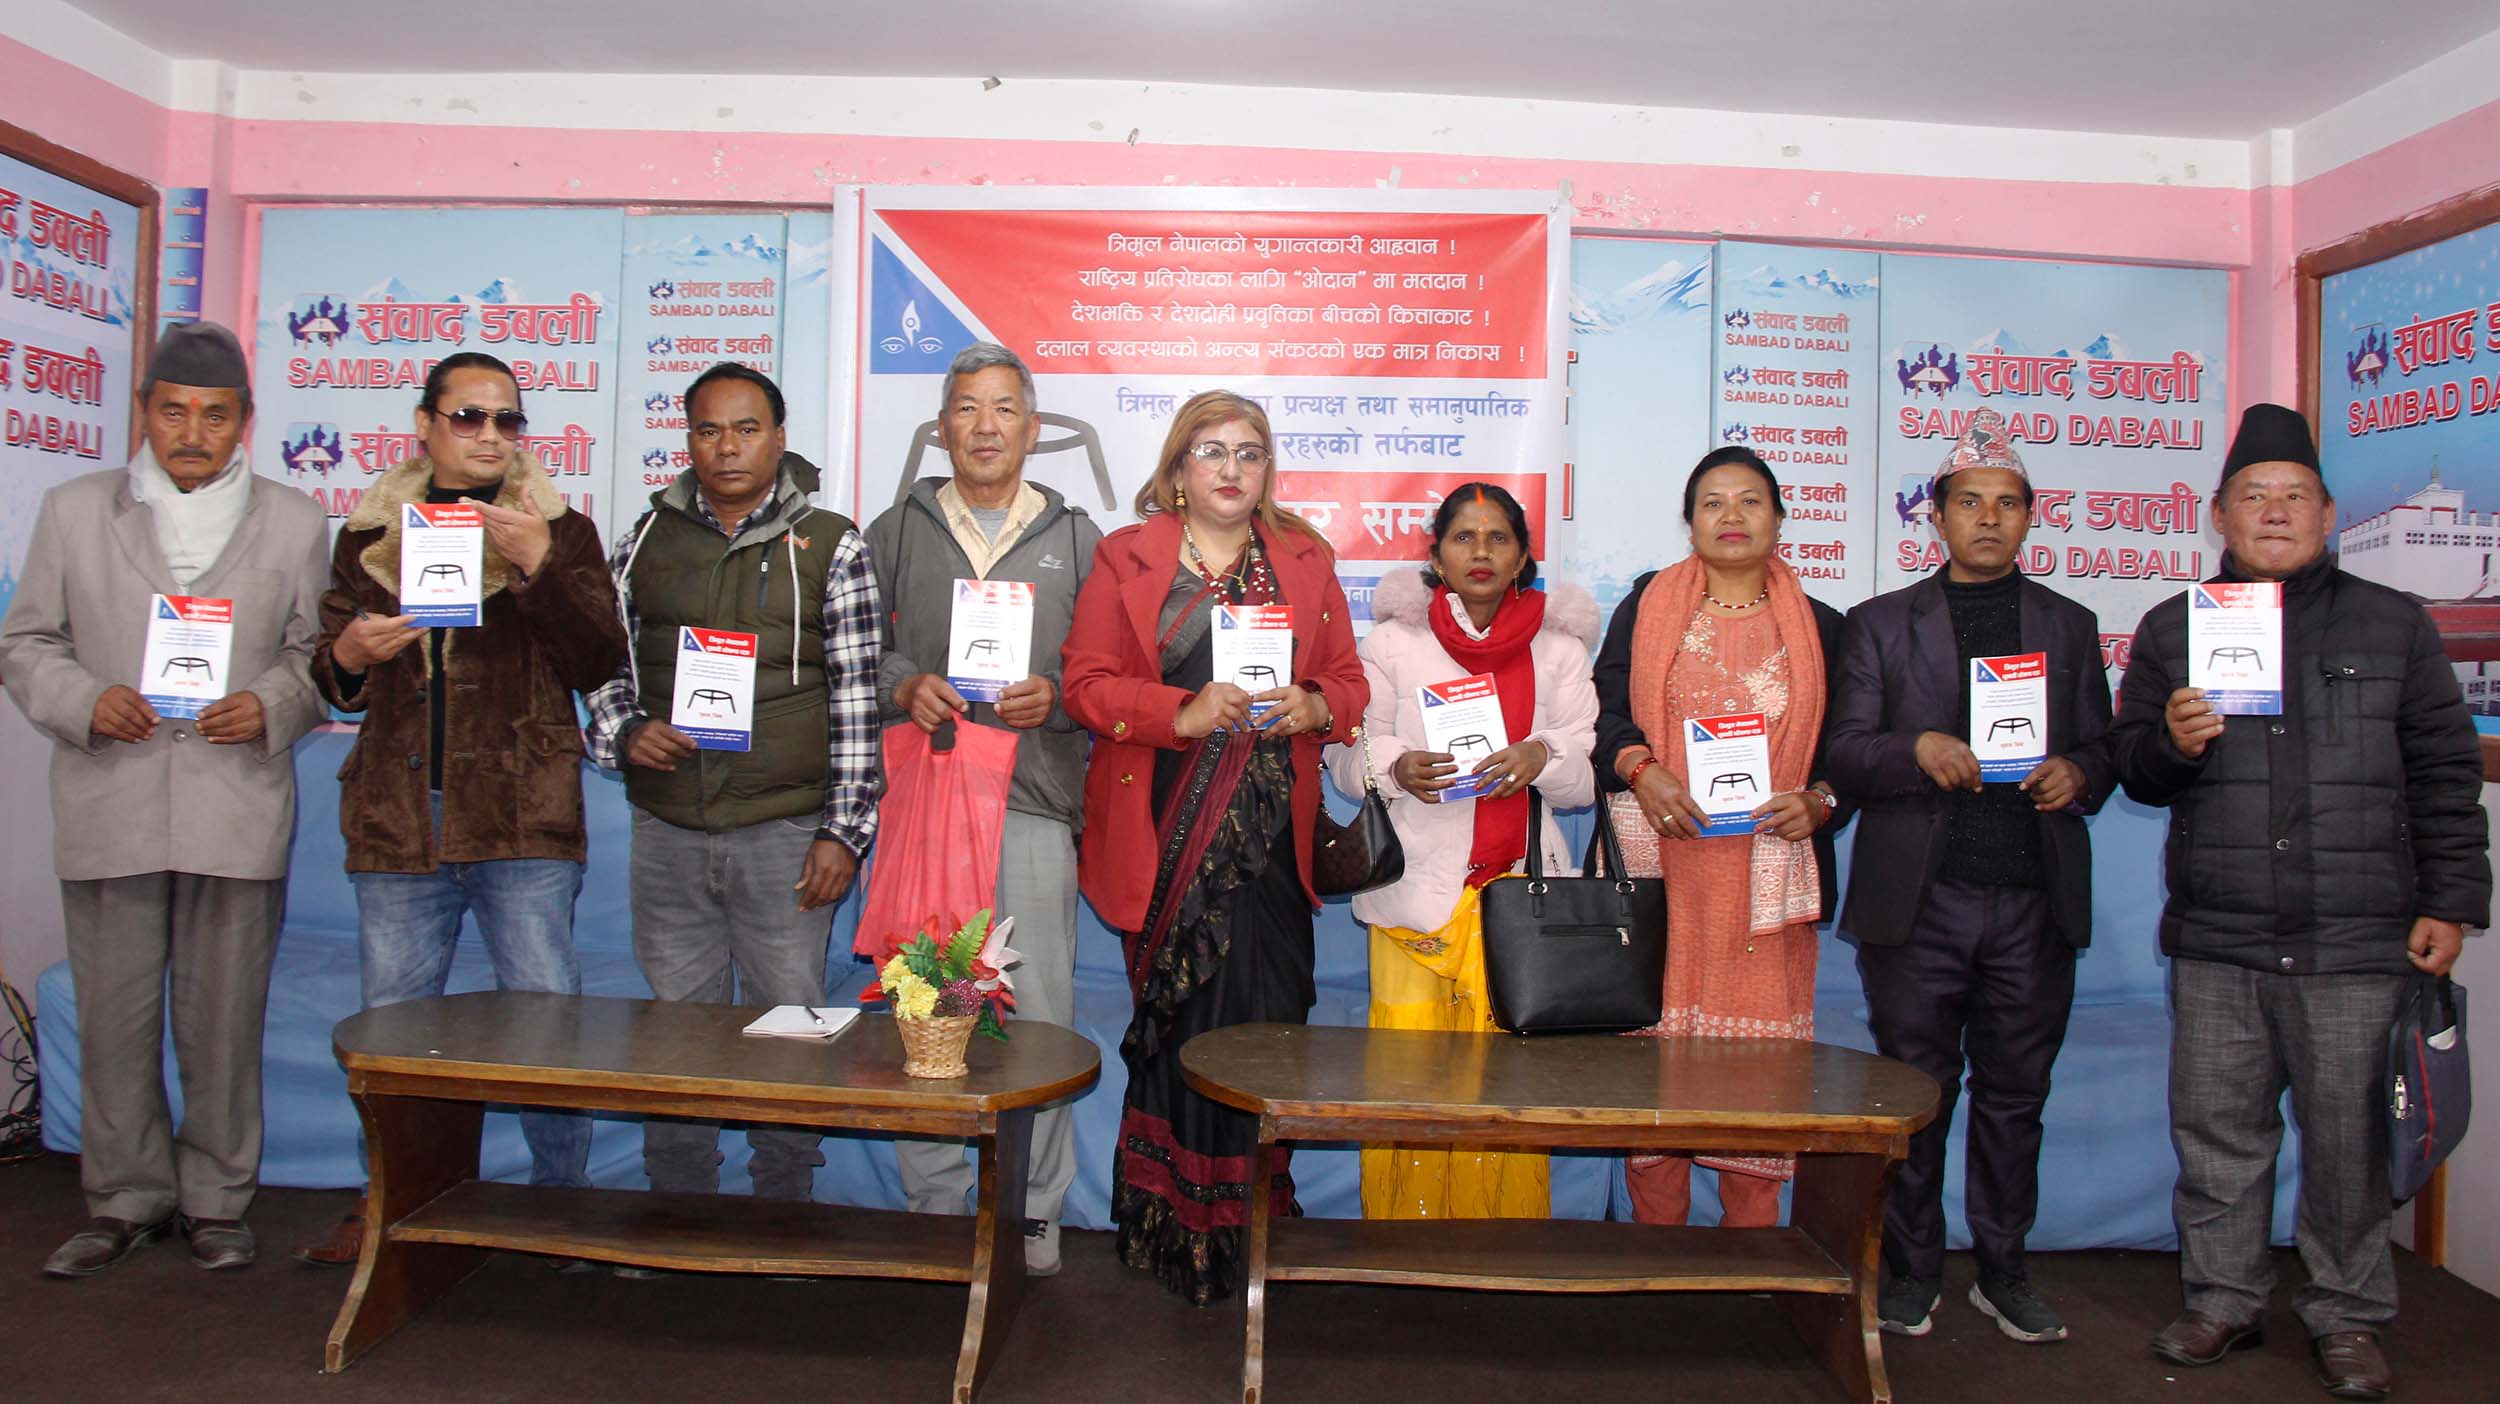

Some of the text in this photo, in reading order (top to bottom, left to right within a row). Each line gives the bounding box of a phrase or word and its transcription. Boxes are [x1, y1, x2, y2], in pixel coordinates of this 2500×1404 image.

[1107, 232, 1163, 257] त्रिमूल
[1168, 232, 1247, 253] नेपालको
[1254, 235, 1364, 257] युगान्तकारी
[12, 261, 108, 319] DABALI
[678, 277, 775, 299] संवाद डबली
[1079, 267, 1137, 290] राष्ट्रिय
[1143, 266, 1233, 289] प्रतिरोधका
[1240, 268, 1286, 289] लागि
[1373, 273, 1396, 289] मा
[1402, 273, 1468, 291] मतदान
[356, 293, 599, 344] संवाद डबली
[650, 304, 774, 317] SAMBAD DABALI
[1072, 300, 1144, 322] देशभक्ति
[1150, 306, 1162, 321] र
[1320, 303, 1381, 324] बीचको
[1753, 309, 1849, 334] संवाद डबली
[675, 333, 773, 354] संवाद डबली
[1035, 341, 1090, 358] दलाल
[1096, 336, 1199, 358] व्यवस्थाको
[1205, 341, 1260, 359] अन्त्य
[1268, 337, 1346, 360] संकटको
[1353, 343, 1387, 360] एक
[1393, 344, 1429, 361] मात्र
[1436, 341, 1502, 361] निकास
[1725, 333, 1849, 352] SAMBAD DABALI
[2392, 308, 2478, 374] संवाद
[512, 360, 597, 390] BALI
[1752, 366, 1849, 389] संवाद डबली
[1966, 347, 2201, 401] संवाद डबली
[1116, 387, 1177, 419] त्रिमूल
[1283, 396, 1347, 416] प्रत्यक्ष
[1357, 396, 1397, 416] तथा
[1408, 393, 1532, 423] समानुपातिक
[1724, 390, 1848, 408] SAMBAD DABALI
[2347, 382, 2461, 435] SAMBAD
[5, 408, 102, 457] DABALI
[645, 418, 688, 429] SAMB
[1751, 424, 1848, 447] संवाद डबली
[1899, 406, 2200, 448] SAMAD DABALI
[1375, 430, 1466, 456] तर्फबाट
[1793, 451, 1847, 465] DABALI
[1800, 482, 1847, 503] डबली
[1792, 508, 1847, 522] DABALI
[2086, 482, 2200, 533] डबली
[1798, 540, 1845, 561] डबली
[1896, 539, 2200, 580] SAAD DABALI
